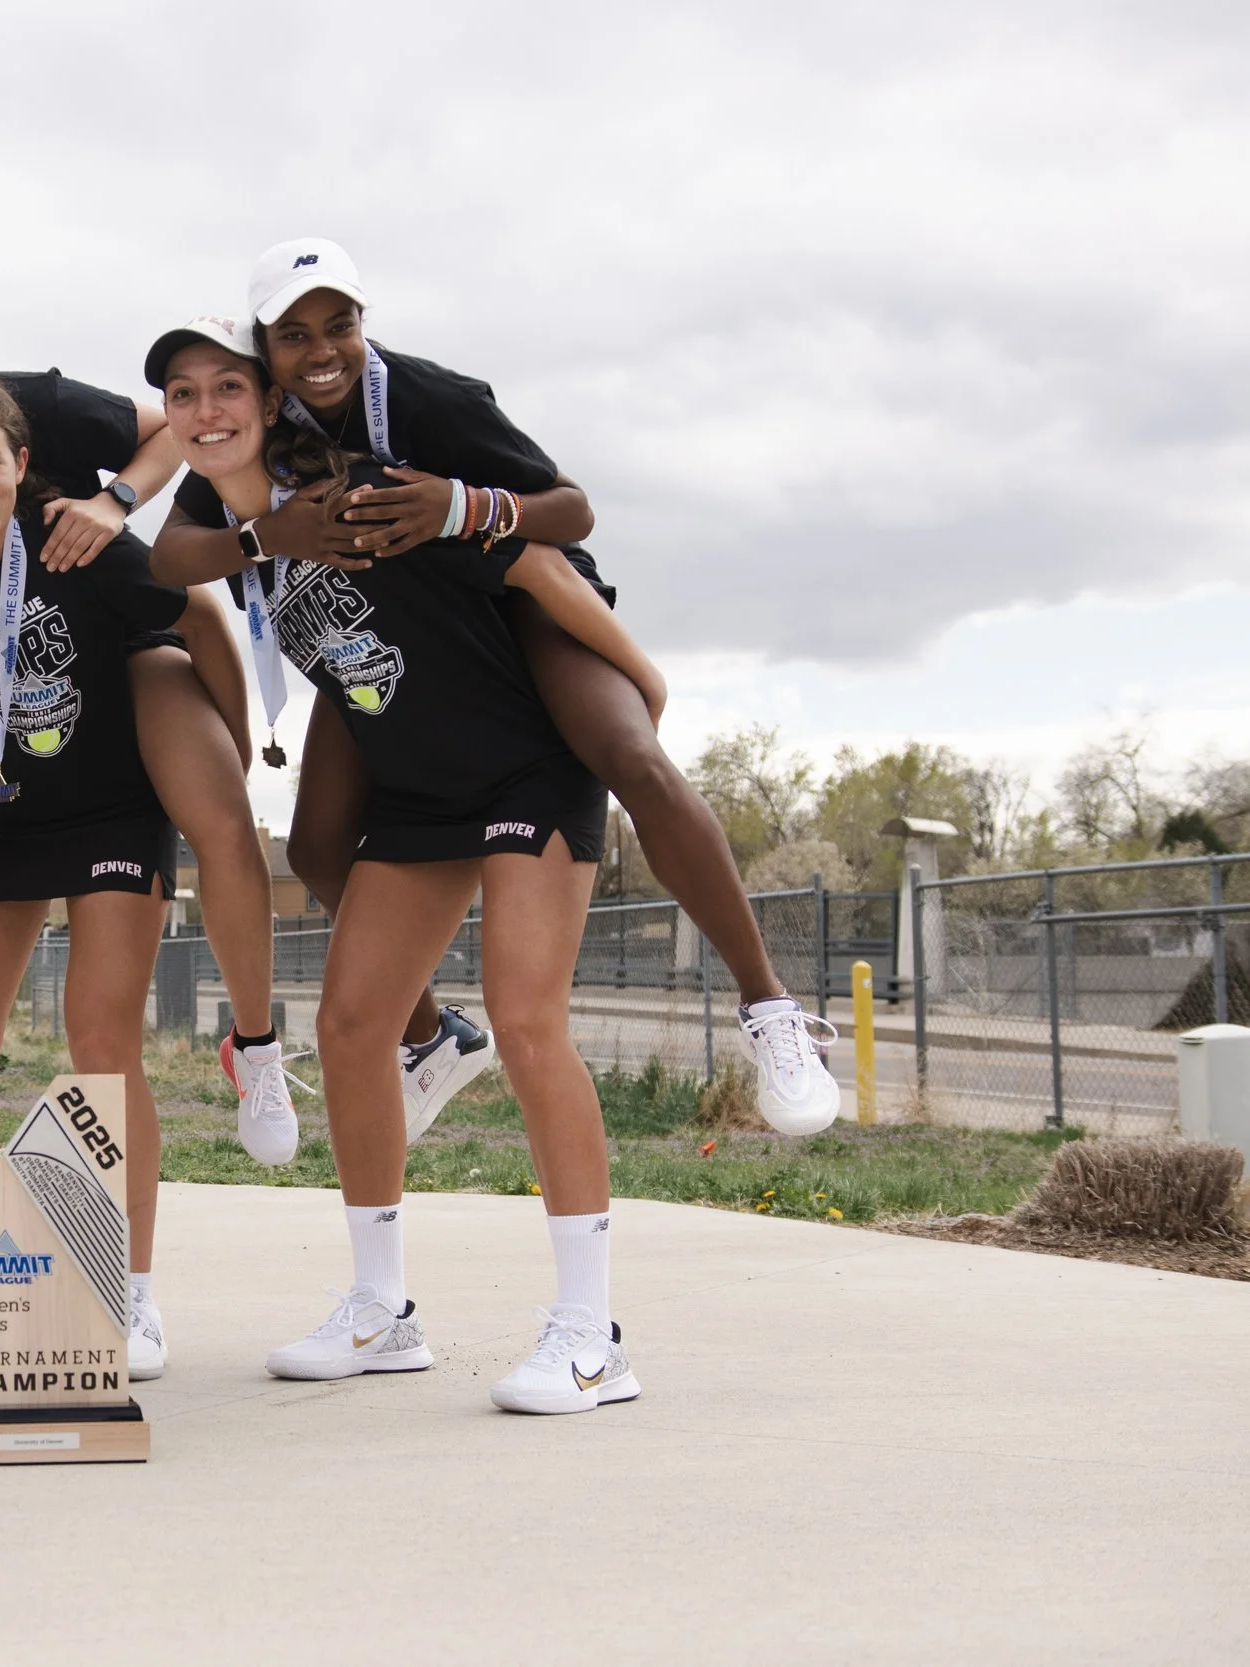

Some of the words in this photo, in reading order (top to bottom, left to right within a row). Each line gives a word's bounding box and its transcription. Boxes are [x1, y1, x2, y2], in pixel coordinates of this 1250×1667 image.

[293, 254, 319, 269] NB
[369, 370, 383, 426] SUMMIT
[375, 431, 386, 456] THE
[7, 542, 22, 597] SUMMIT
[290, 560, 320, 587] LEAGU
[5, 600, 17, 626] THE
[250, 601, 263, 640] SUMMIT
[341, 656, 363, 666] AGUE
[12, 681, 66, 703] UMMIT
[21, 699, 57, 710] LEAGUE
[27, 709, 51, 718] TENNIS
[484, 822, 535, 841] DENVER
[91, 860, 142, 878] DENVER
[56, 1086, 124, 1170] 2025
[11, 1157, 28, 1180] SOUTH
[26, 1180, 45, 1206] DAKOTA
[25, 1166, 45, 1193] THOMAS
[26, 1156, 39, 1174] ORAL
[38, 1174, 59, 1204] ROBERTS
[33, 1157, 52, 1182] OMAHA
[43, 1160, 60, 1183] NORTH
[58, 1183, 78, 1209] DAKOTA
[54, 1165, 74, 1192] KANSAS
[71, 1191, 84, 1207] CITY
[66, 1171, 86, 1197] DENVER
